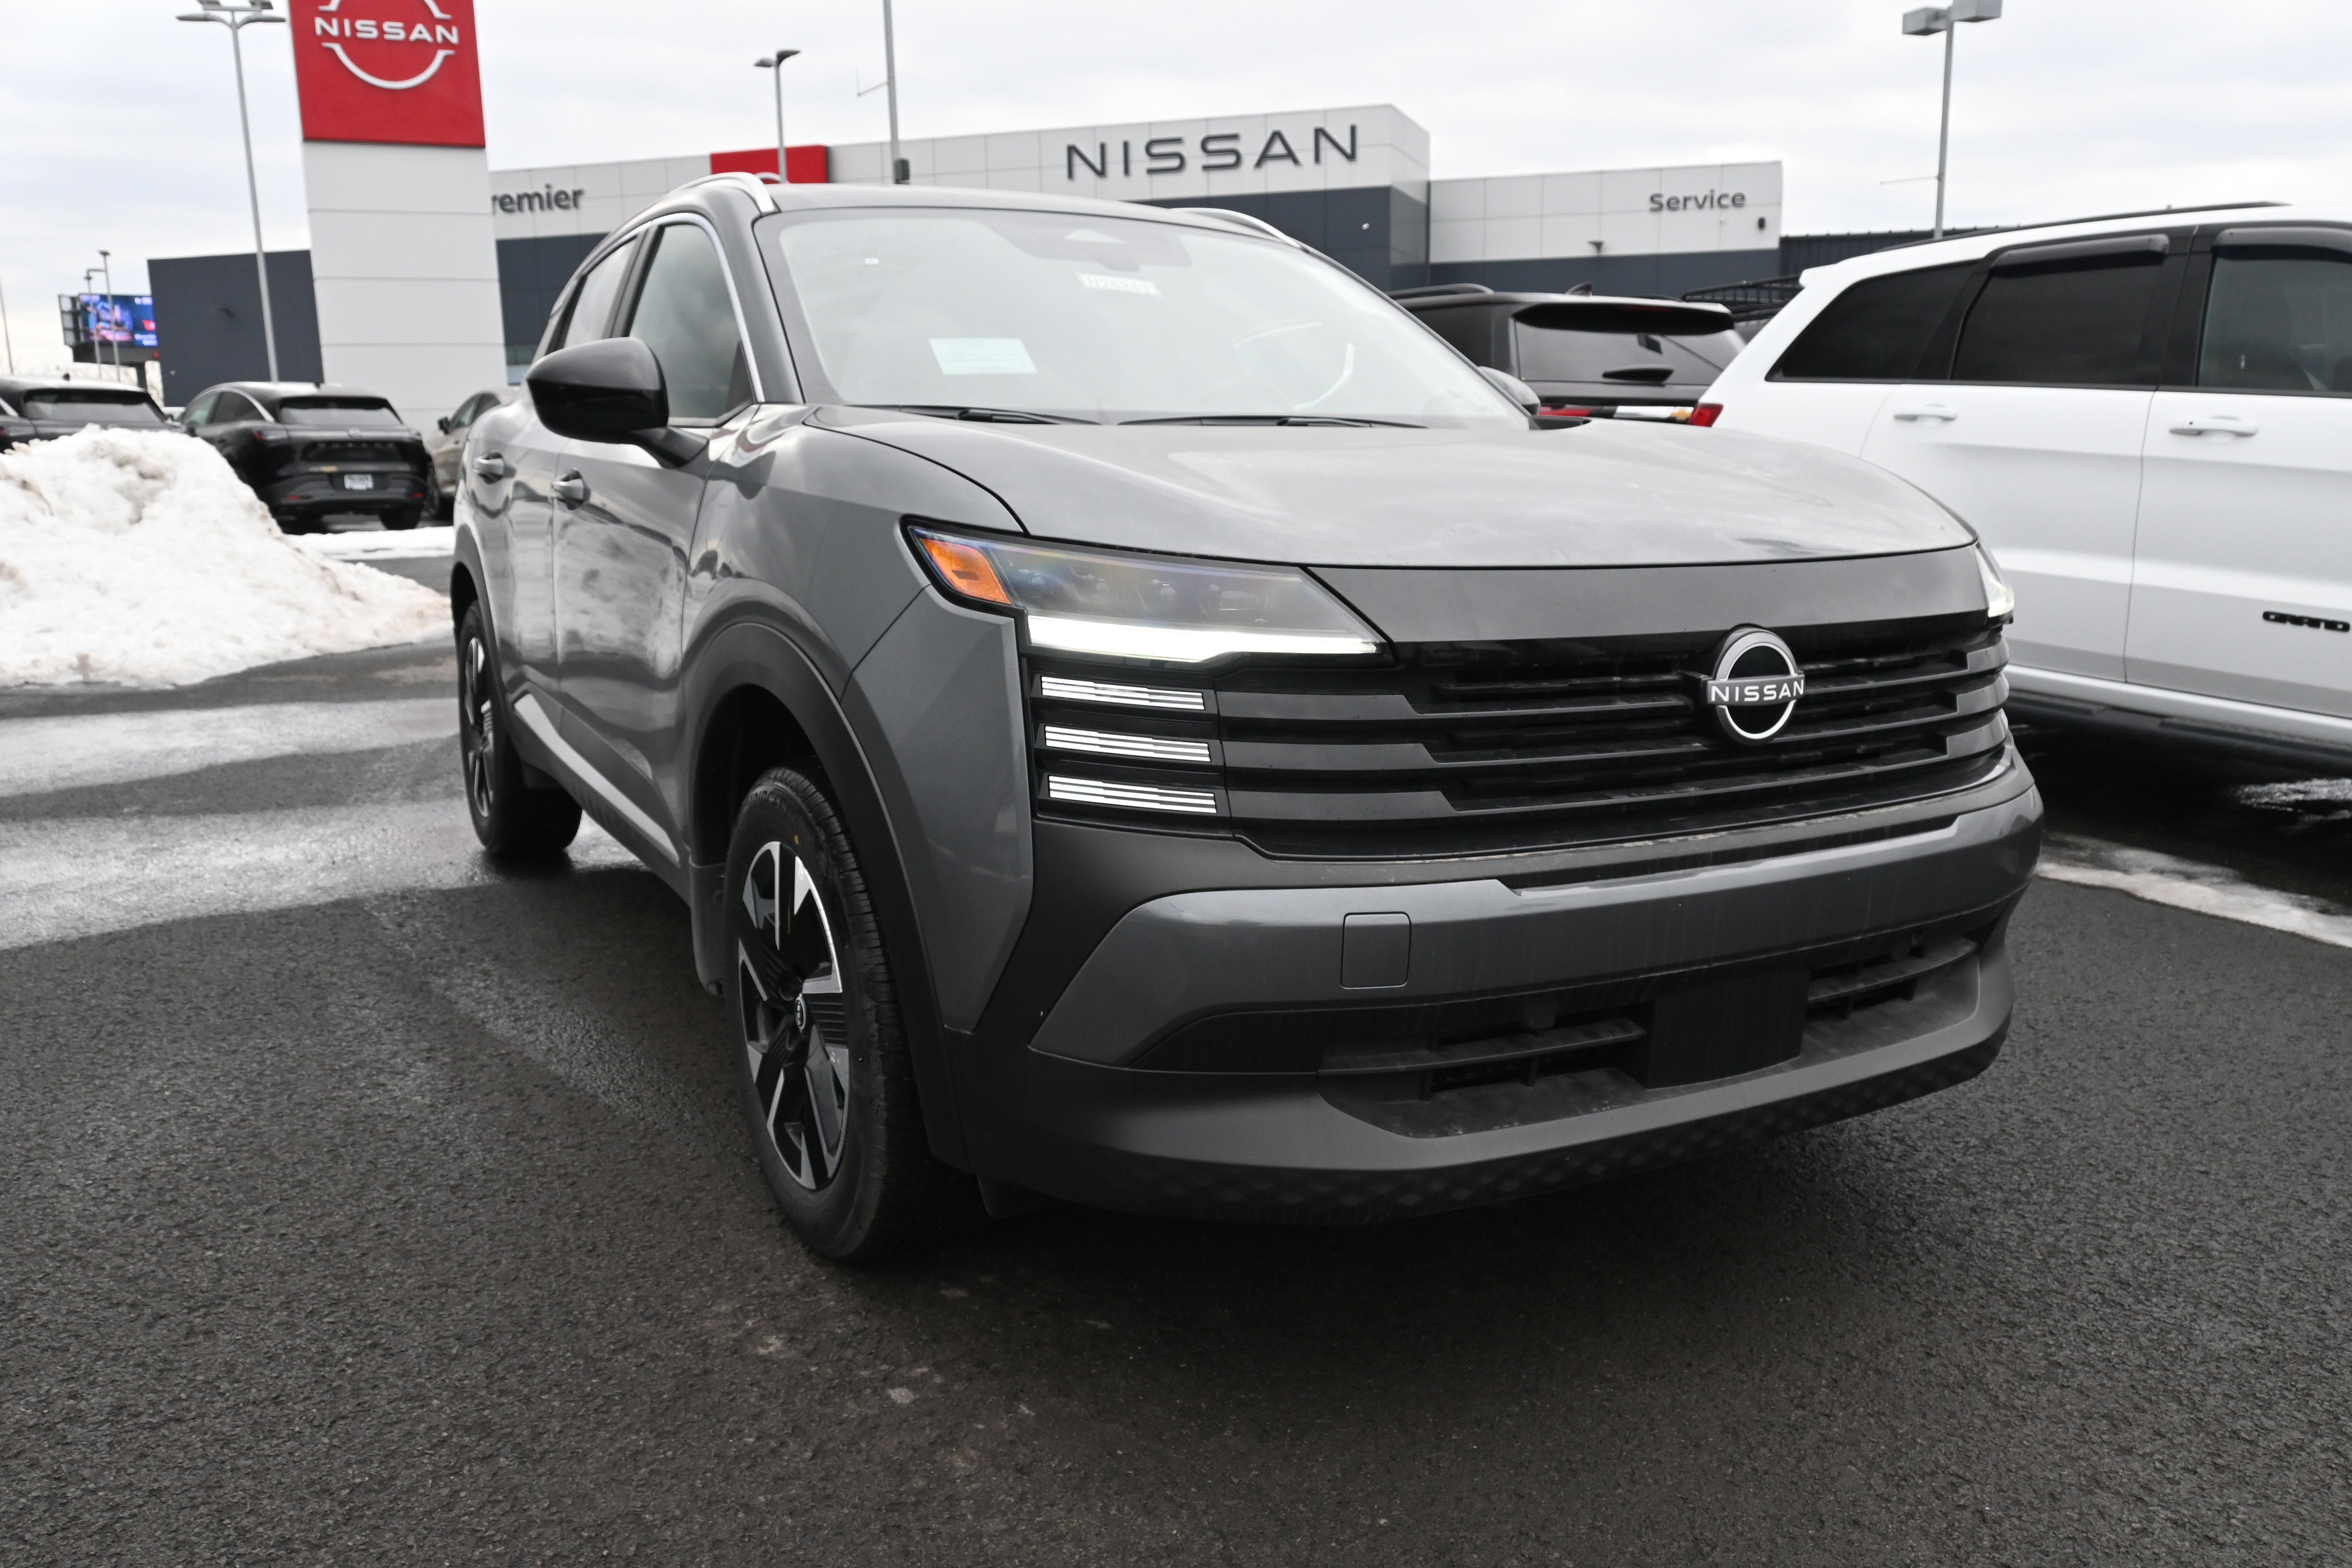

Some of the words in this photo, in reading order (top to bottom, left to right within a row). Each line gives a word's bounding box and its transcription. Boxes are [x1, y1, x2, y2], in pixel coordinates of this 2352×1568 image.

[314, 17, 459, 45] NISSAN
[1067, 123, 1358, 180] NISSAN
[491, 182, 584, 215] remier
[1649, 188, 1746, 212] Service
[1711, 679, 1804, 702] NISSAN
